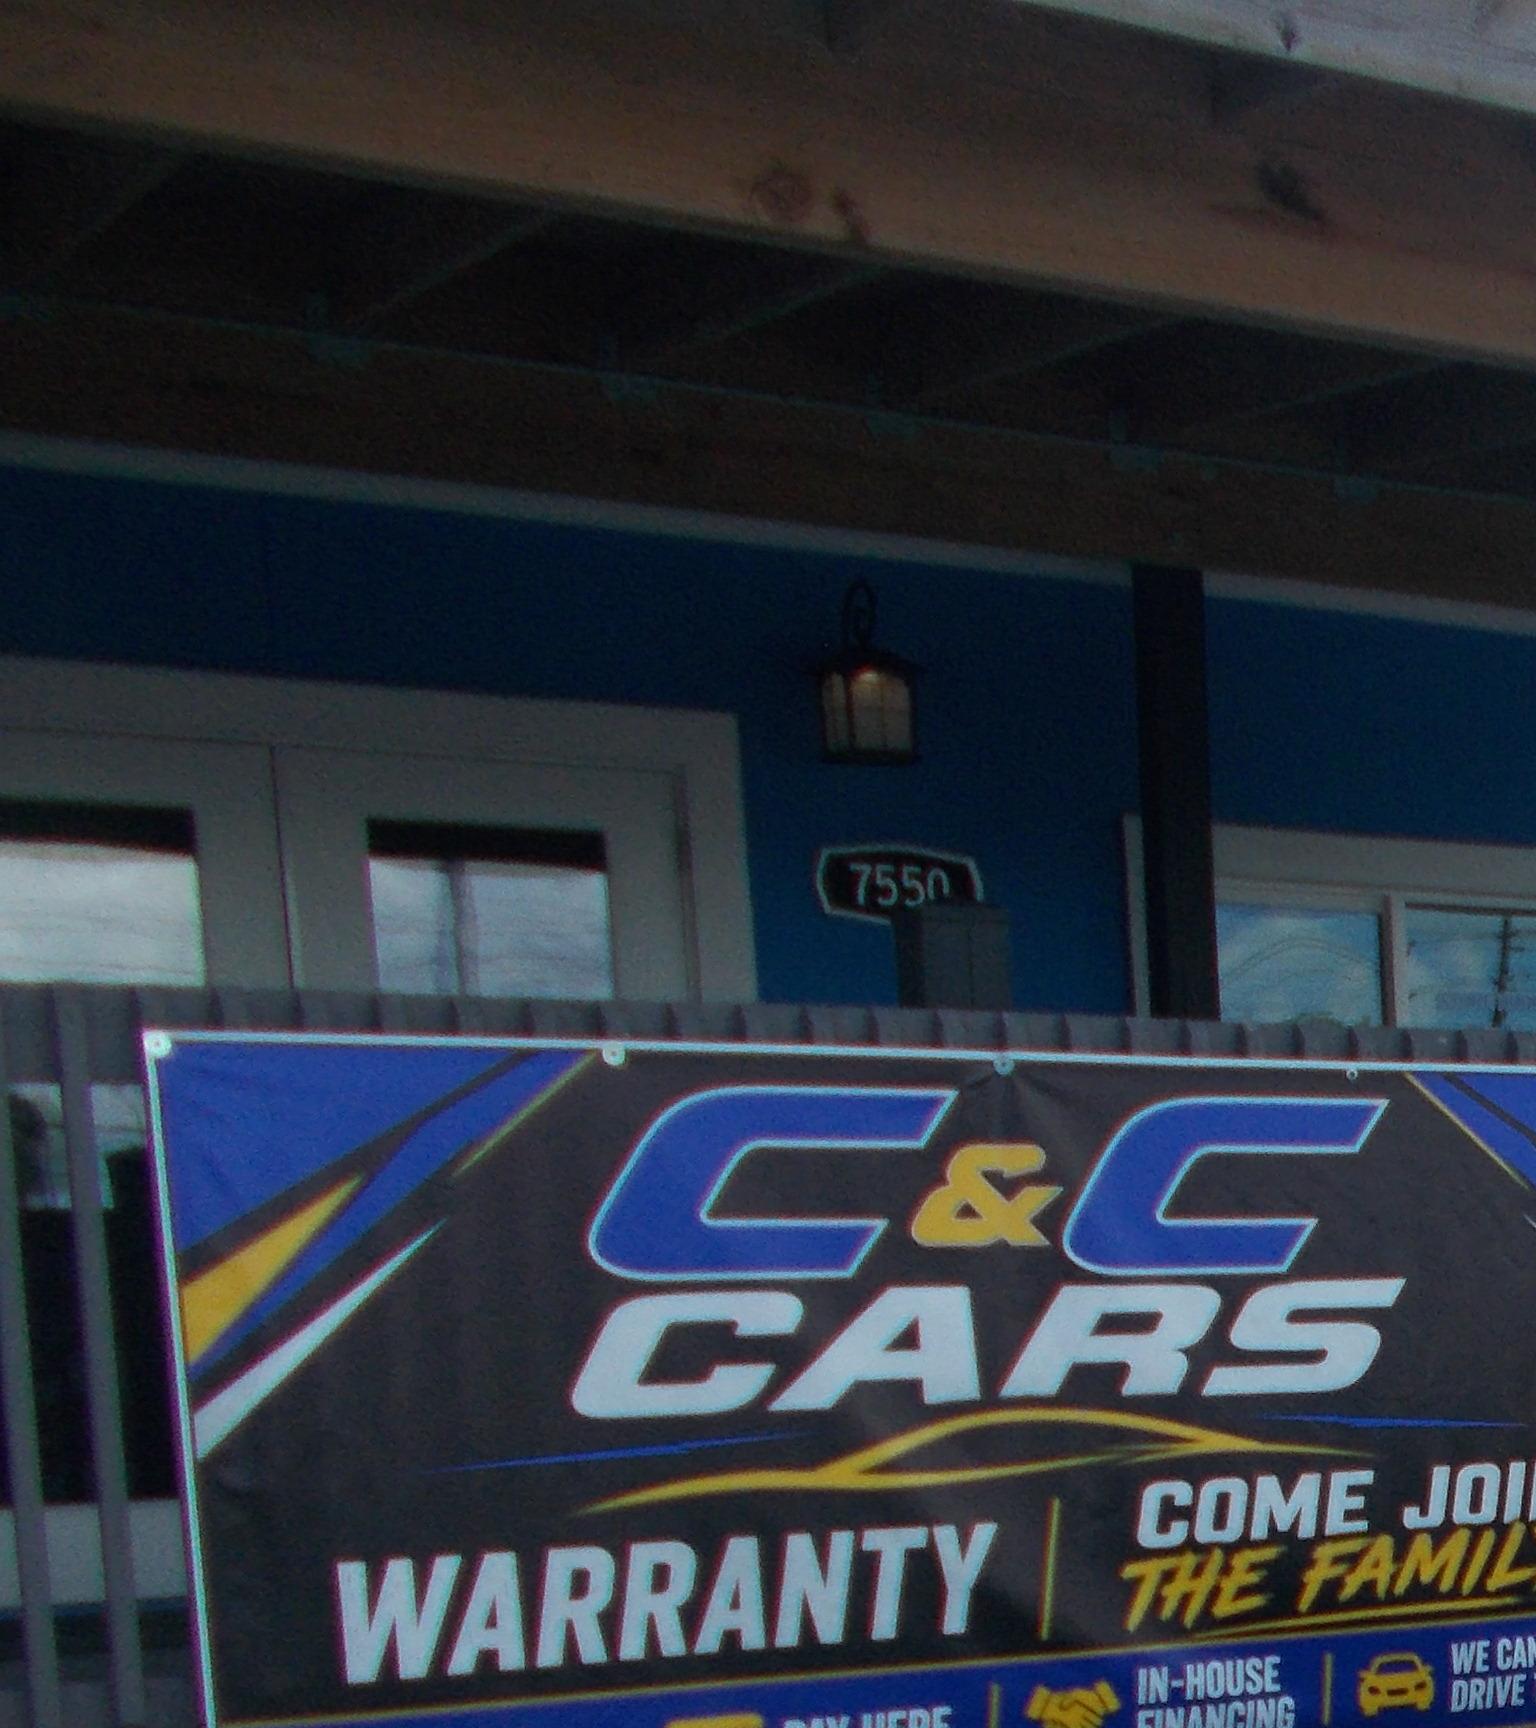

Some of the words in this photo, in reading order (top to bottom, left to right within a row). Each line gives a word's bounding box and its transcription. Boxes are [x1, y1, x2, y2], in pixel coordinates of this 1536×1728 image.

[849, 863, 950, 907] 7550
[571, 1277, 1406, 1418] CARS
[1137, 1470, 1374, 1549] COME
[335, 1522, 998, 1686] WARRANTY
[1120, 1543, 1288, 1633] THE
[1136, 1655, 1282, 1704] IN-HOUSE
[1451, 1639, 1493, 1675] WE
[1451, 1674, 1528, 1712] DRIVE
